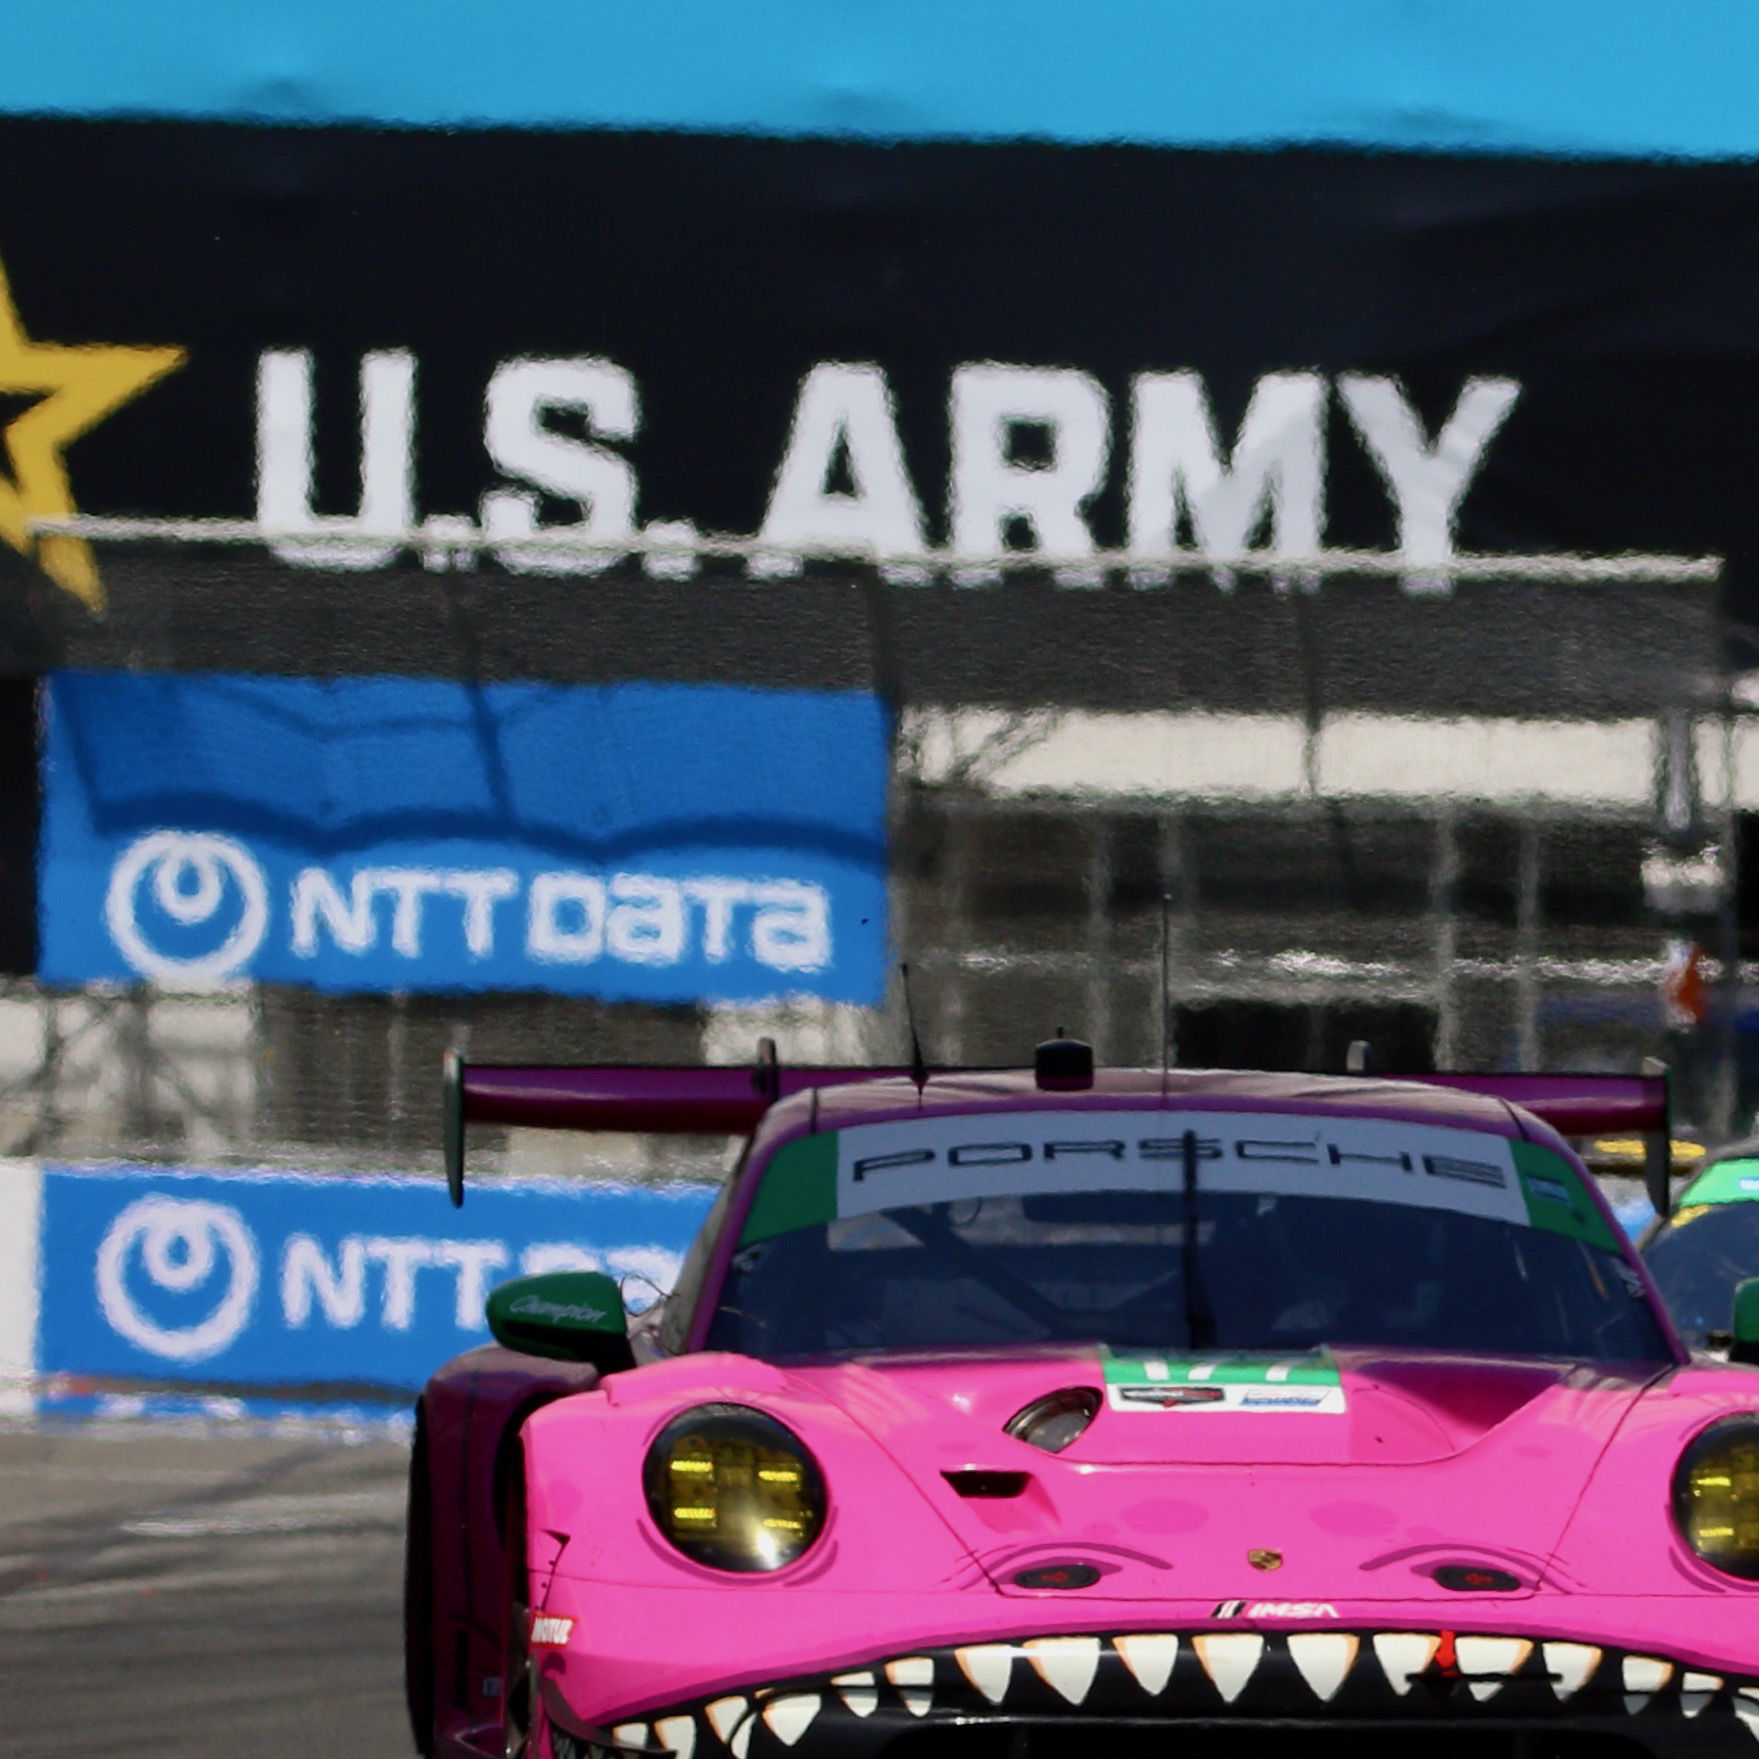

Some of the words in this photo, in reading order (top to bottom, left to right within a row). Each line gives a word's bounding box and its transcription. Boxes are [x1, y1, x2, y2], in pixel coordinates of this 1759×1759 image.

[254, 346, 702, 582] U.S.
[746, 358, 1522, 596] ARMY
[290, 865, 522, 962] NTT
[852, 1138, 1508, 1188] PORSCHE
[1248, 1602, 1340, 1619] IMSA
